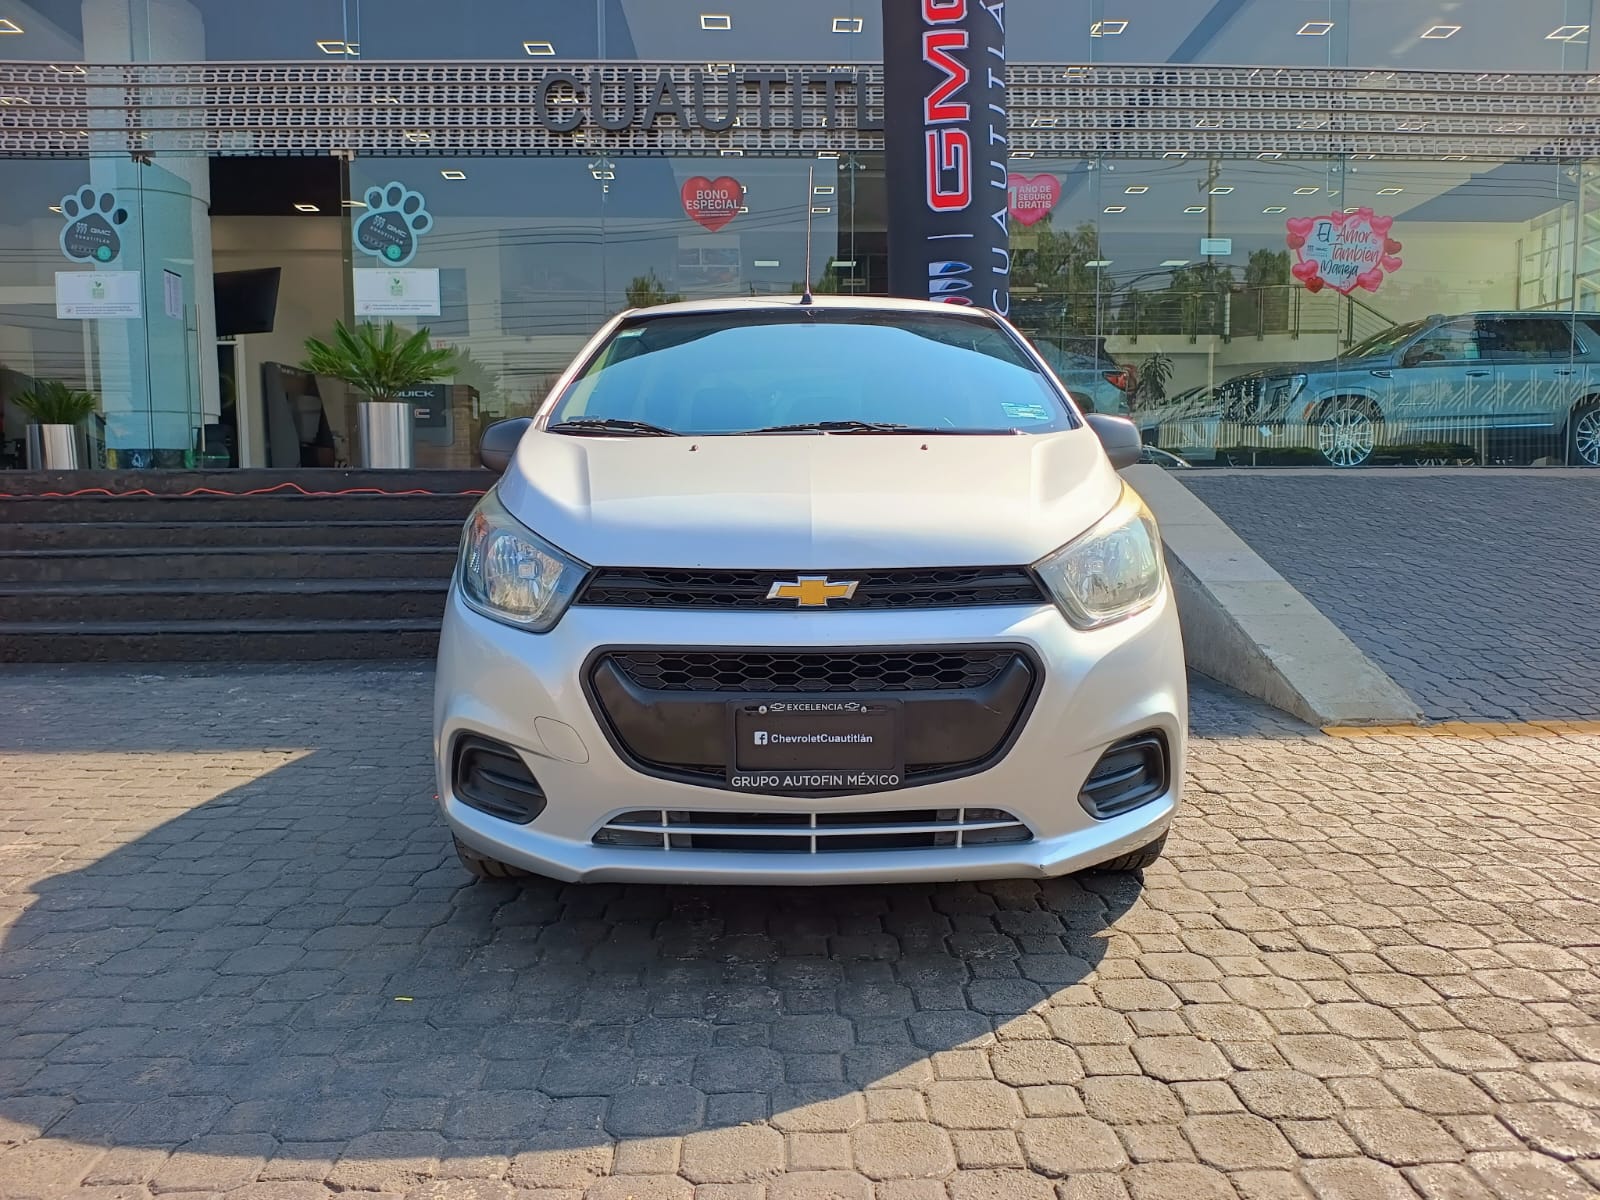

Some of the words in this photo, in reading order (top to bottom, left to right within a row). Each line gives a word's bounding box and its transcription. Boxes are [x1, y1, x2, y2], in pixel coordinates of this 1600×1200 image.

[696, 189, 729, 200] BONO
[1039, 185, 1052, 193] DE
[1018, 193, 1052, 201] SEGURO
[686, 199, 739, 210] ESPECIAL
[1017, 200, 1052, 209] GRATIS
[1335, 223, 1373, 244] Amor
[1320, 260, 1359, 280] Maneja
[786, 703, 844, 711] EXCELENCIA
[771, 733, 873, 744] ChevroletCuautitlán
[731, 776, 780, 787] GRUPO
[783, 775, 843, 786] AUTOFIN
[847, 772, 899, 786] MÉXICO
